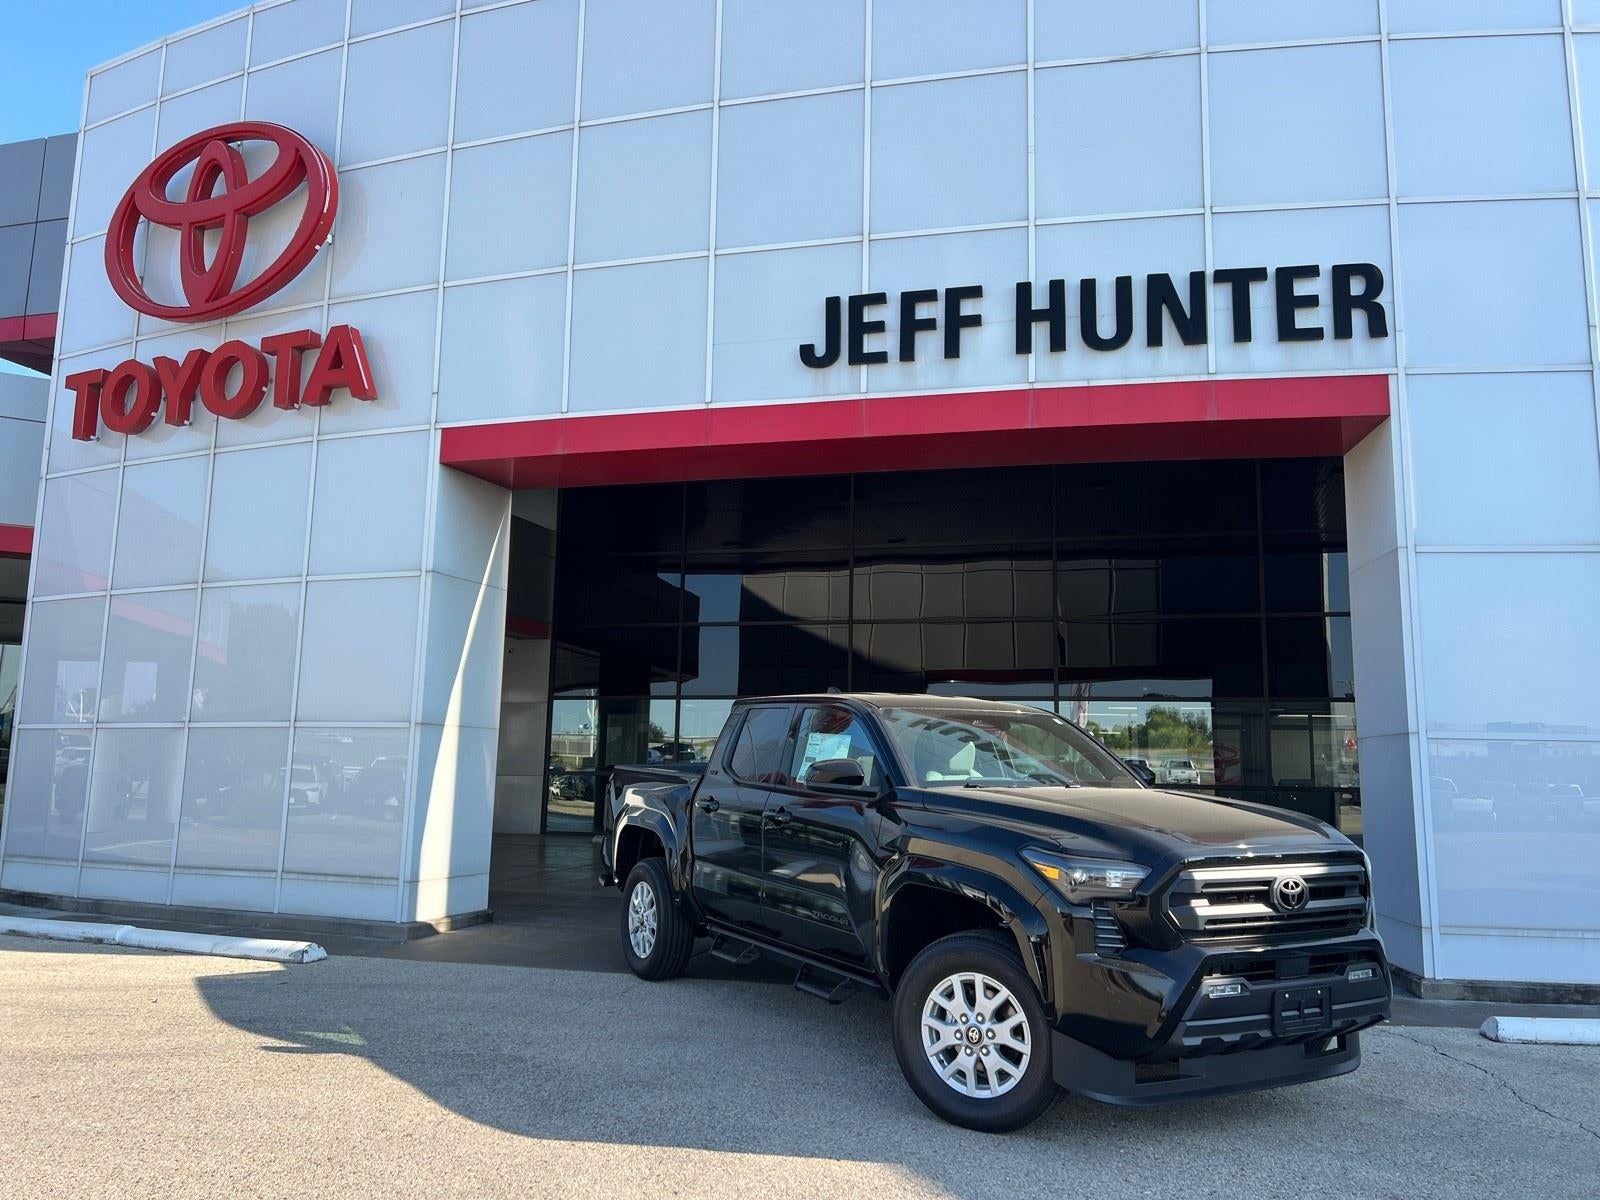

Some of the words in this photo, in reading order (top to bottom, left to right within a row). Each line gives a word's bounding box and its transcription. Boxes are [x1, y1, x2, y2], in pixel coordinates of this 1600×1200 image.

[799, 285, 983, 369] JEFF
[1016, 262, 1389, 354] HUNTER
[66, 324, 378, 442] TOYOTA
